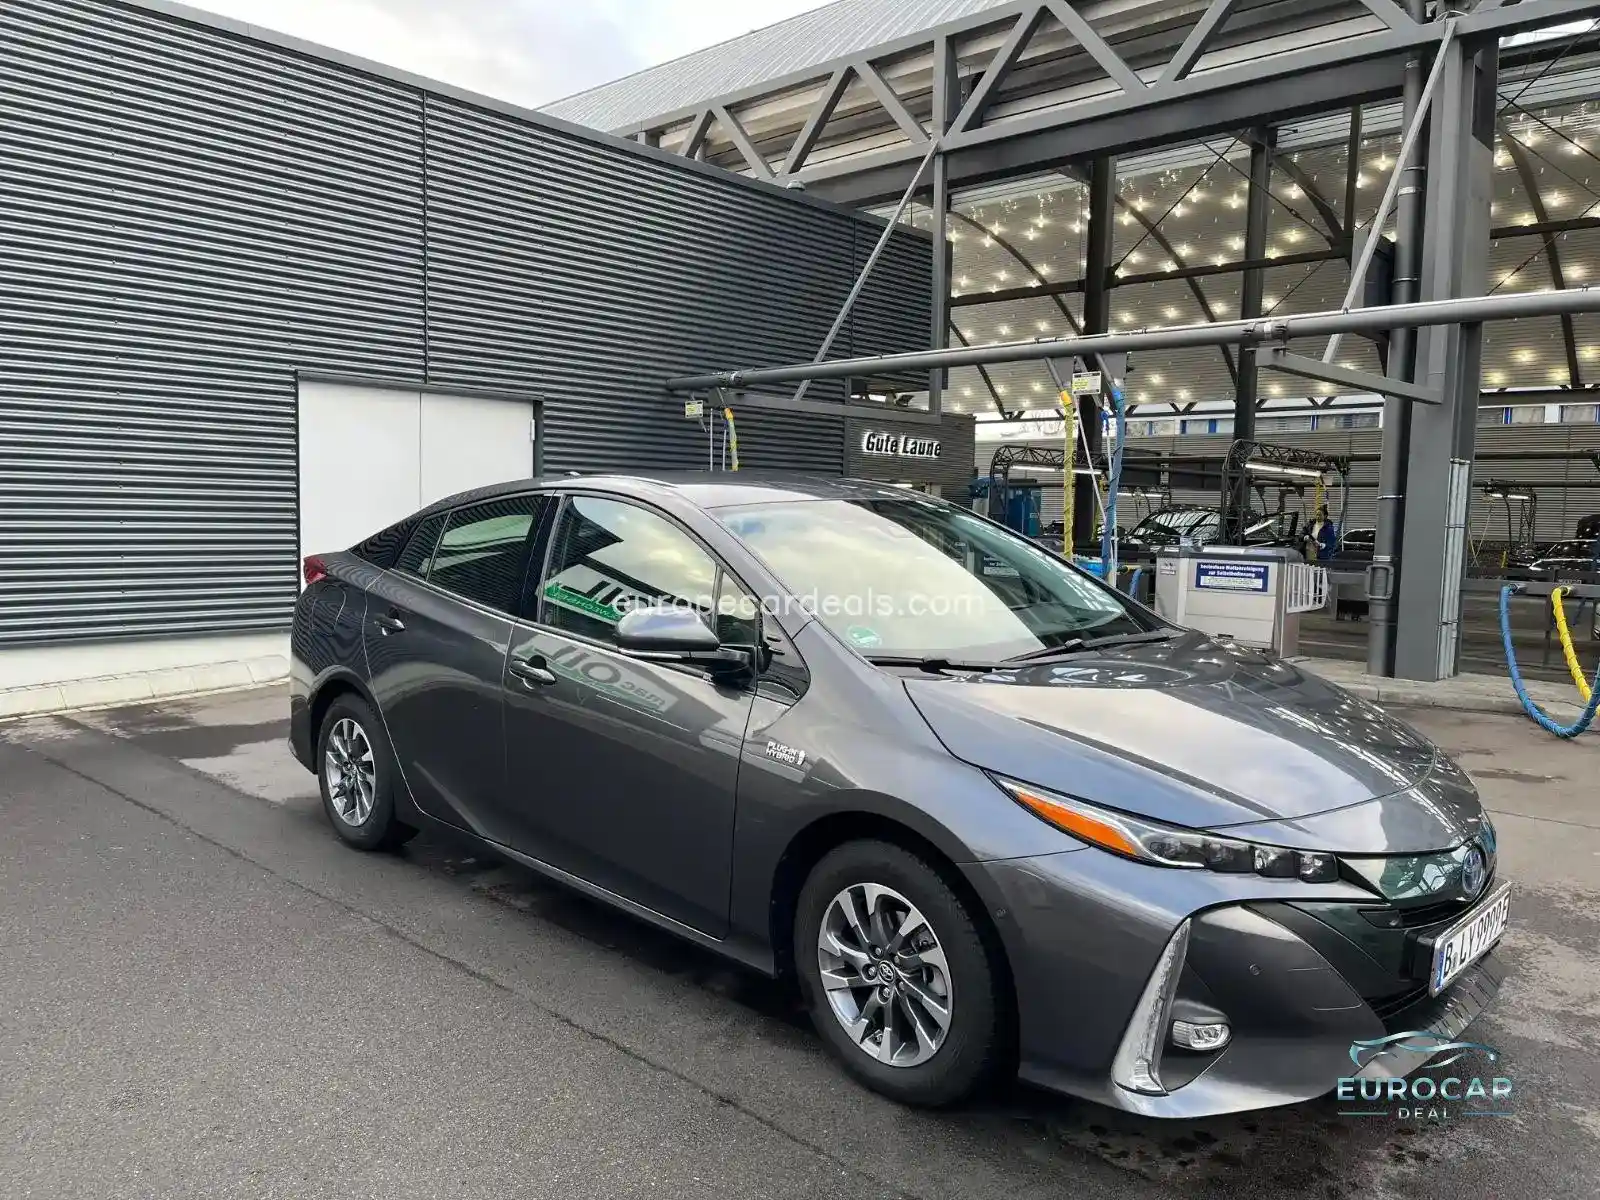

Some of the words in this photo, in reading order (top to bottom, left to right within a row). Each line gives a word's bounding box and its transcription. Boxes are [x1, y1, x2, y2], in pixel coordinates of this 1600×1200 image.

[865, 432, 898, 453] Gute
[900, 435, 941, 457] Laune
[766, 748, 795, 763] HYBRID
[1443, 942, 1453, 976] B
